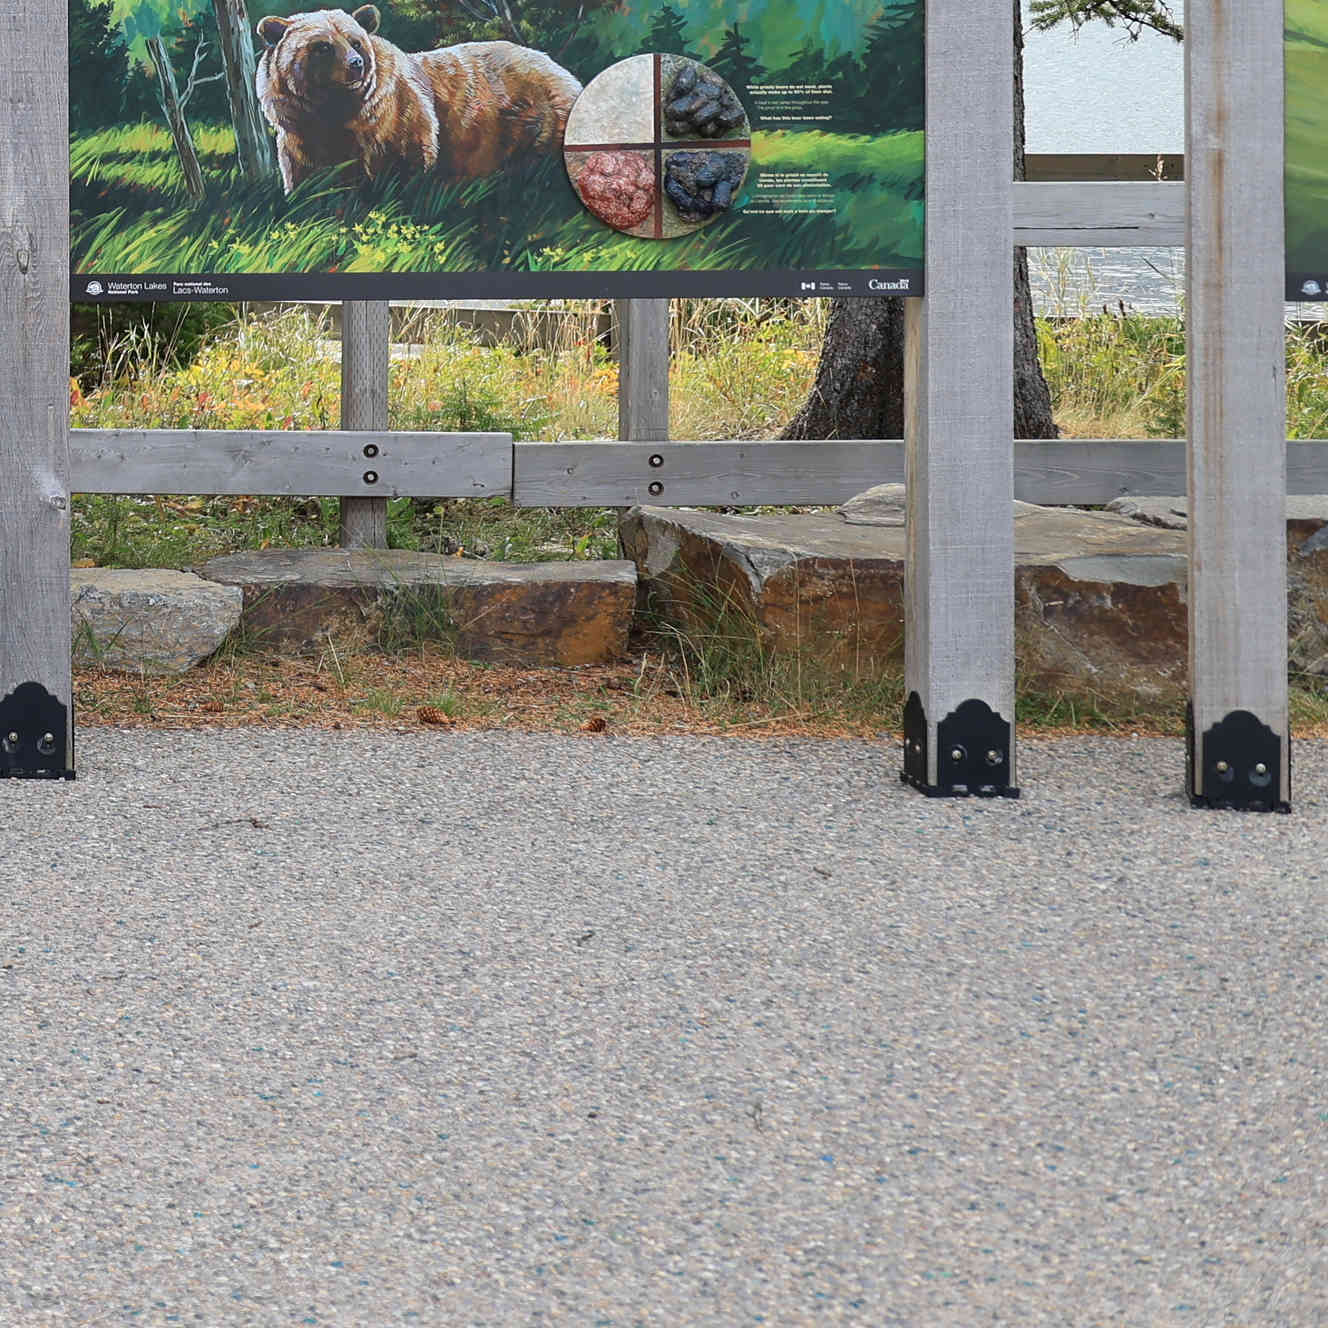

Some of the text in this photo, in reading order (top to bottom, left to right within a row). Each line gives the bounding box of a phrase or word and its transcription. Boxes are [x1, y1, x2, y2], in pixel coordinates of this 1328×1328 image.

[108, 282, 167, 290] Waterton Lakes
[868, 279, 910, 290] Canada
[173, 286, 228, 294] Lacs-Waterton
